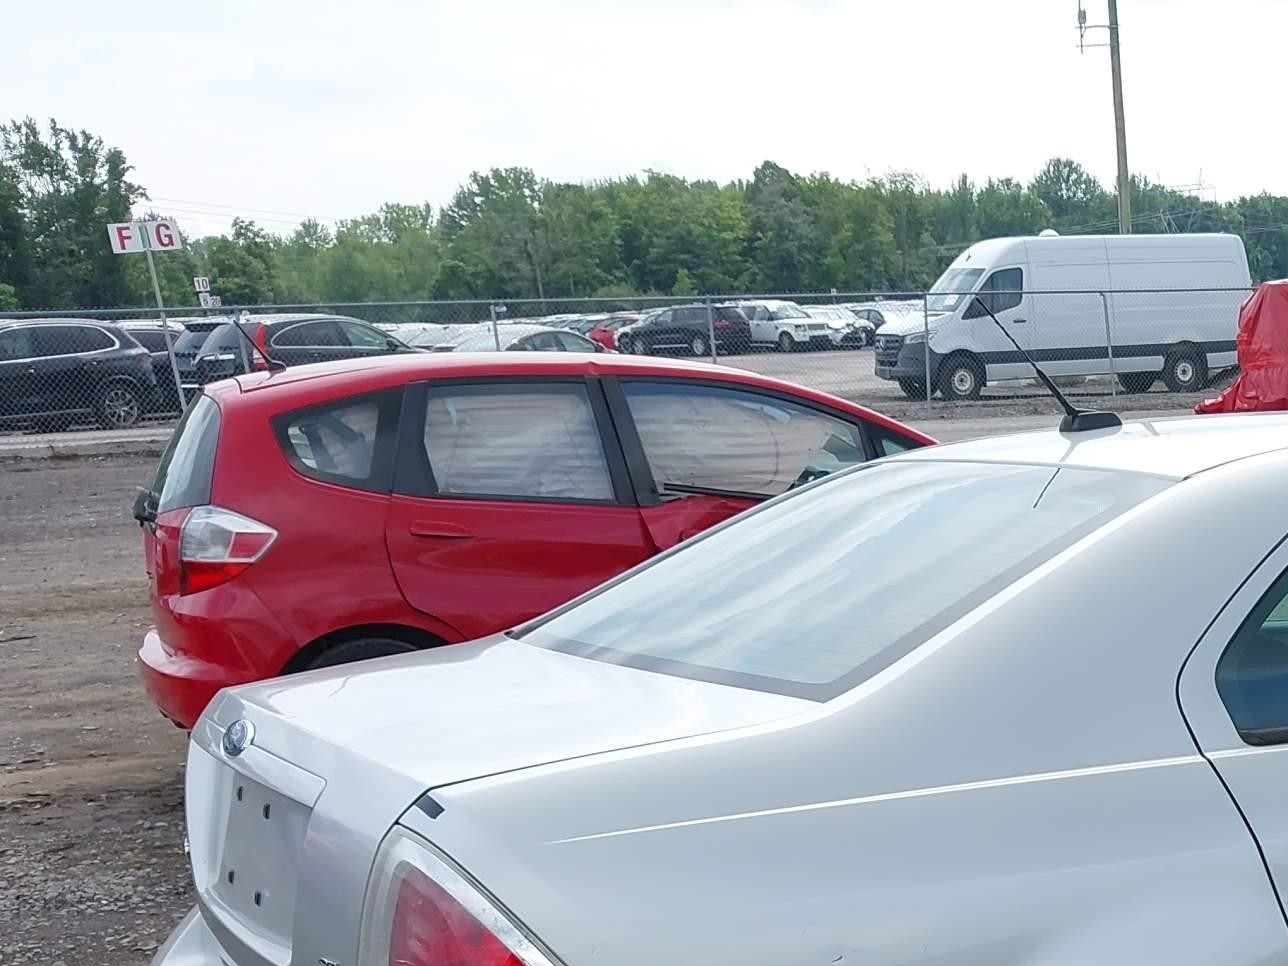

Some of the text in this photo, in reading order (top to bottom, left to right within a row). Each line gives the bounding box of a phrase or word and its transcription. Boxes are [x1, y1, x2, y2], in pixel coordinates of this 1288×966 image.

[115, 225, 132, 251] F
[155, 222, 175, 248] G
[195, 278, 209, 290] 10
